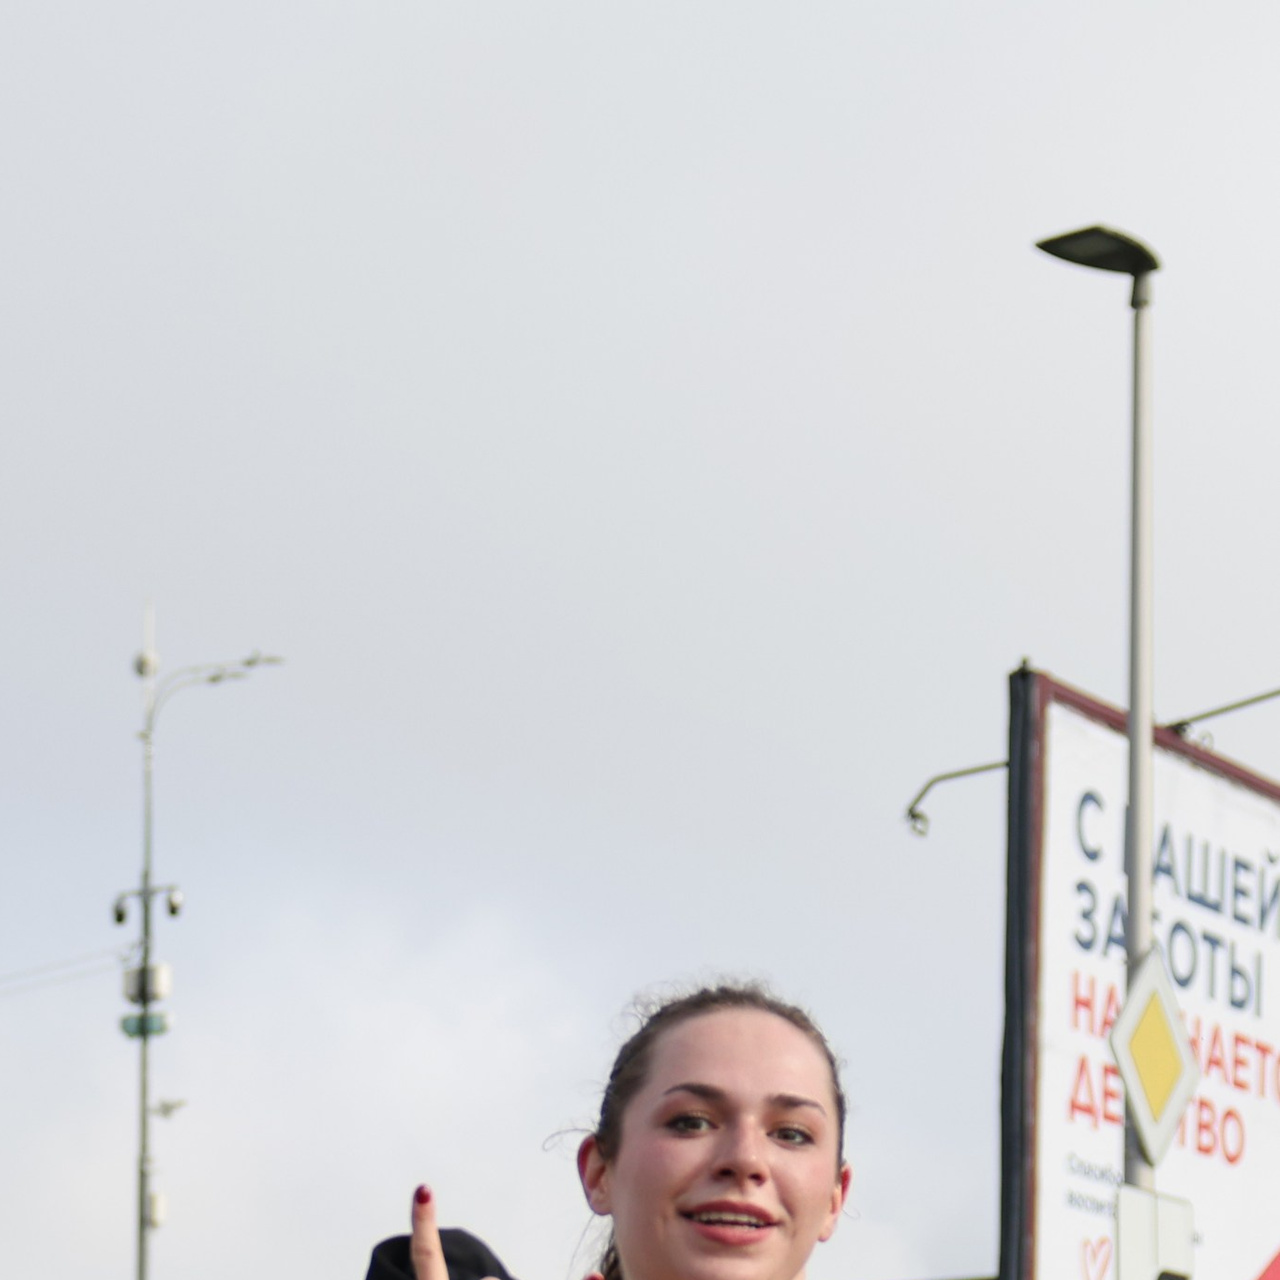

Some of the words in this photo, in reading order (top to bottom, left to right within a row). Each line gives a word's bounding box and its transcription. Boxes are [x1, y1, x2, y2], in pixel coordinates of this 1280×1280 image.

[1076, 790, 1105, 862] С
[1150, 822, 1280, 945] АШЕЙ
[1075, 881, 1262, 1019] ЗАОТЫ
